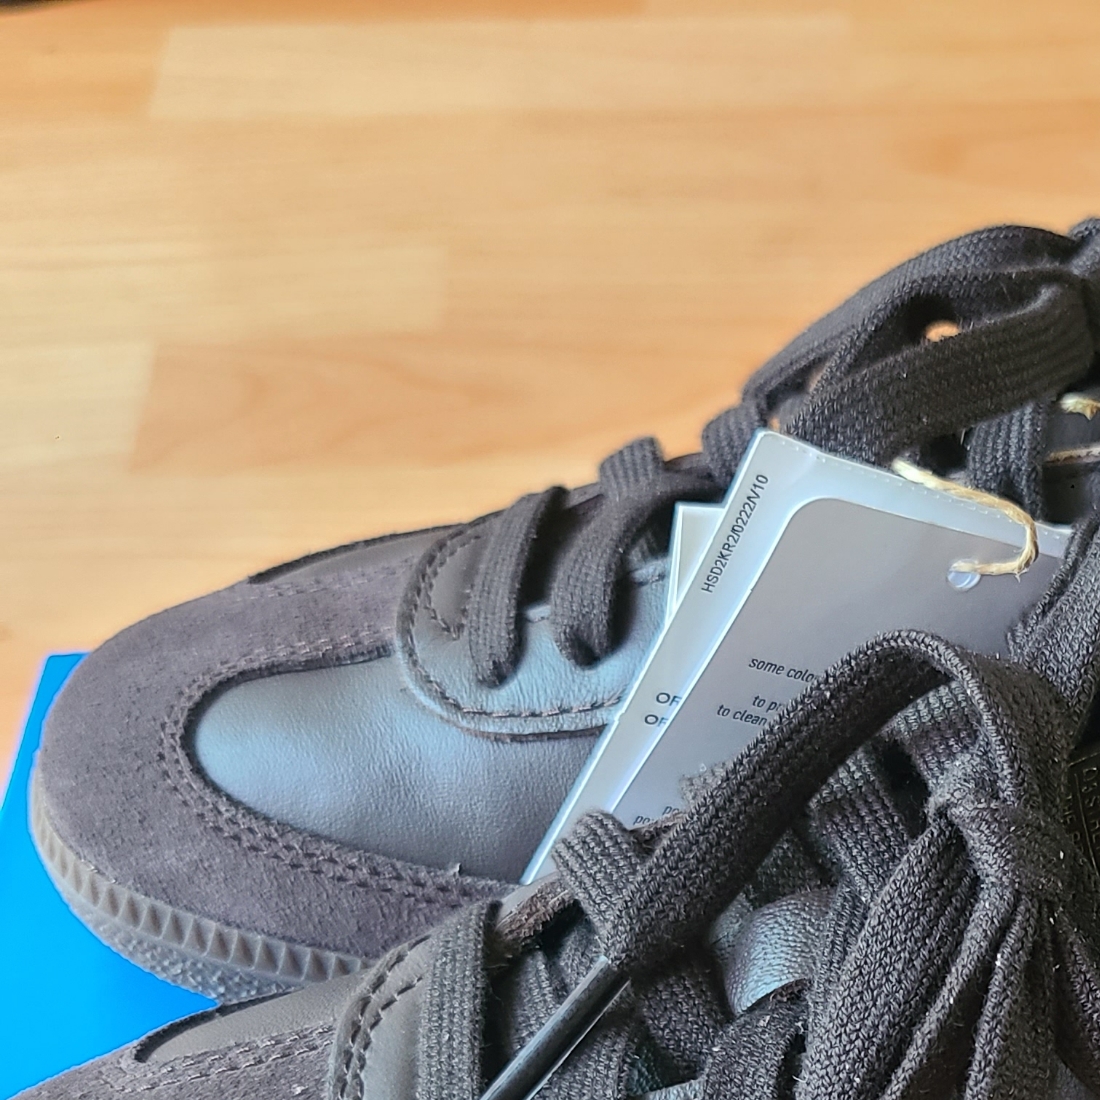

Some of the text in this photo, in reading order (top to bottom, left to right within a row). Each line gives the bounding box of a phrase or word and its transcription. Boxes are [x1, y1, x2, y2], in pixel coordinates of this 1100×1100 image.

[749, 658, 817, 684] some colo
[752, 695, 766, 708] to
[717, 704, 731, 717] to
